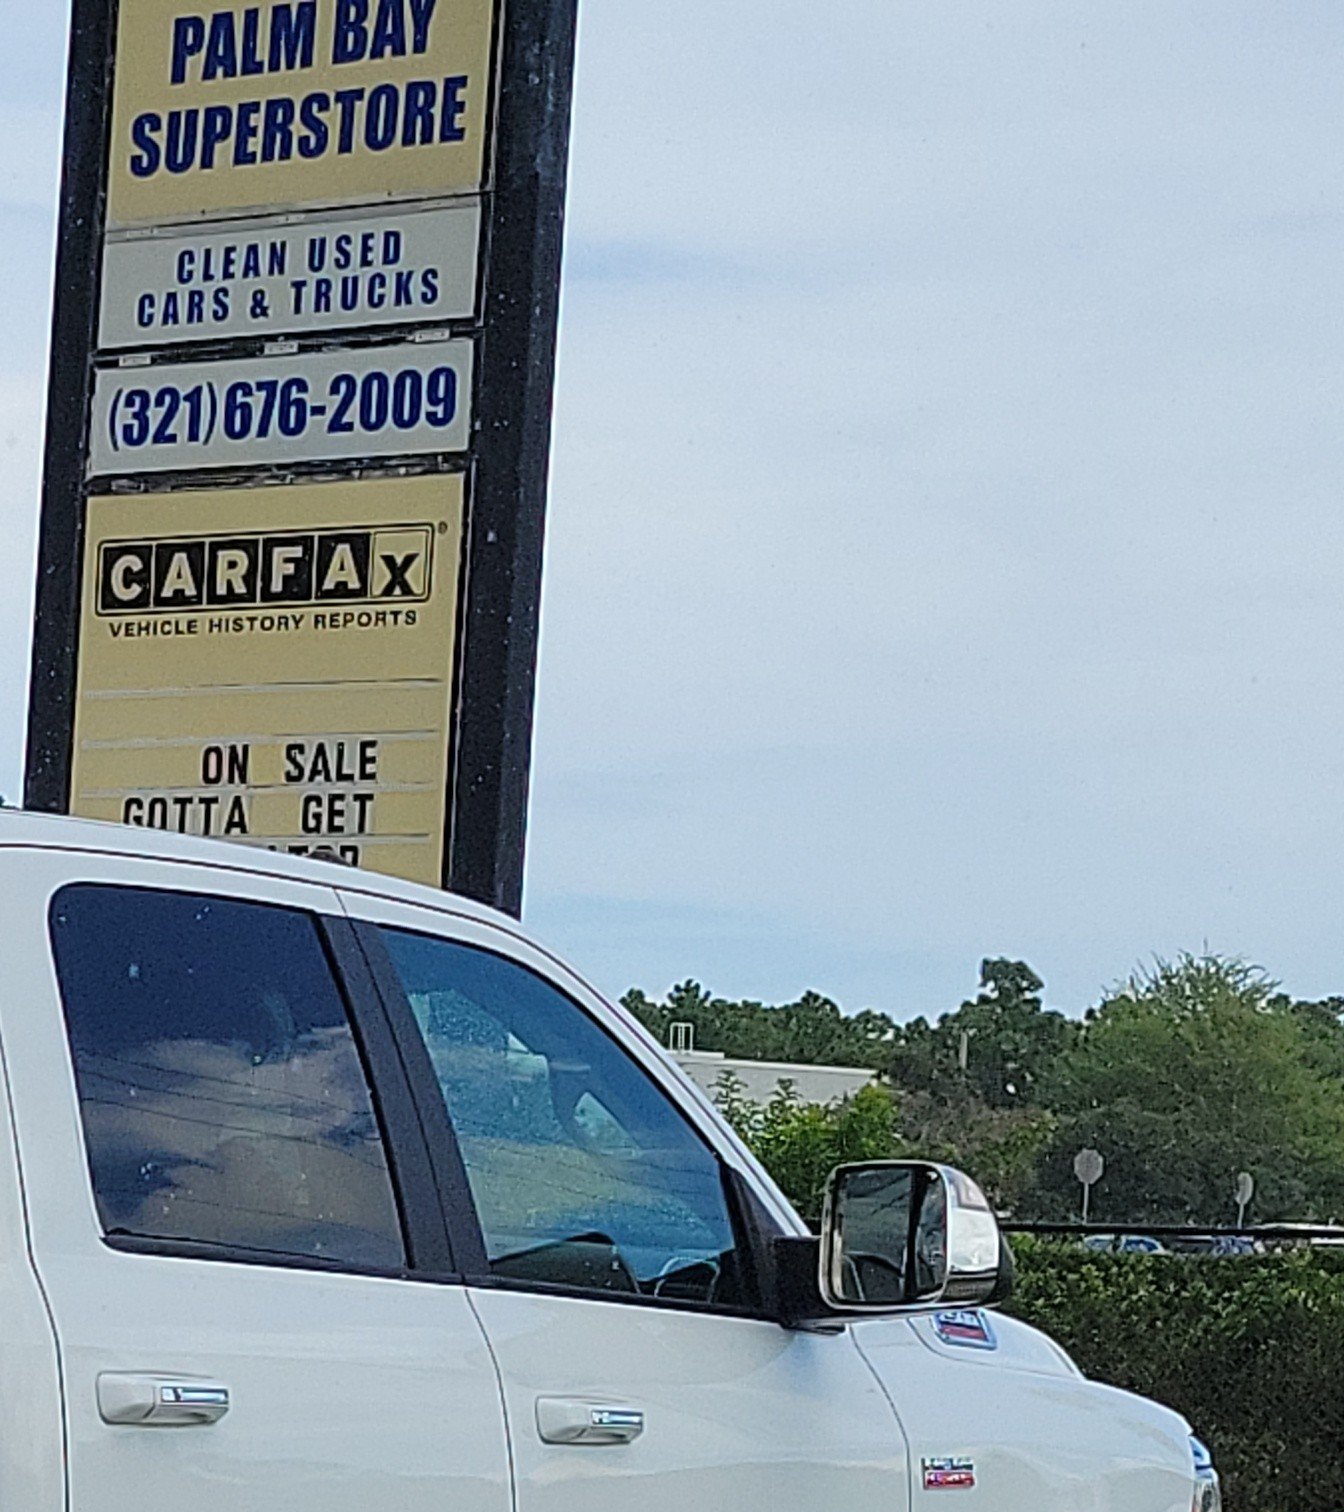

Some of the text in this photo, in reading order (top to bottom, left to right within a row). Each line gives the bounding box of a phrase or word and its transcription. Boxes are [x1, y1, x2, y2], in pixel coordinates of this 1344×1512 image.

[170, 0, 436, 85] PALM BAY
[129, 75, 469, 178] SUPERSTORE
[177, 230, 402, 285] CLEAN USED
[137, 269, 439, 328] CARS & TRUCKS
[105, 535, 425, 606] CARFAX
[109, 609, 418, 638] VEHICLE HISTORY REPORTS
[201, 740, 378, 785] ON SALE
[122, 793, 375, 836] GOTTA GET
